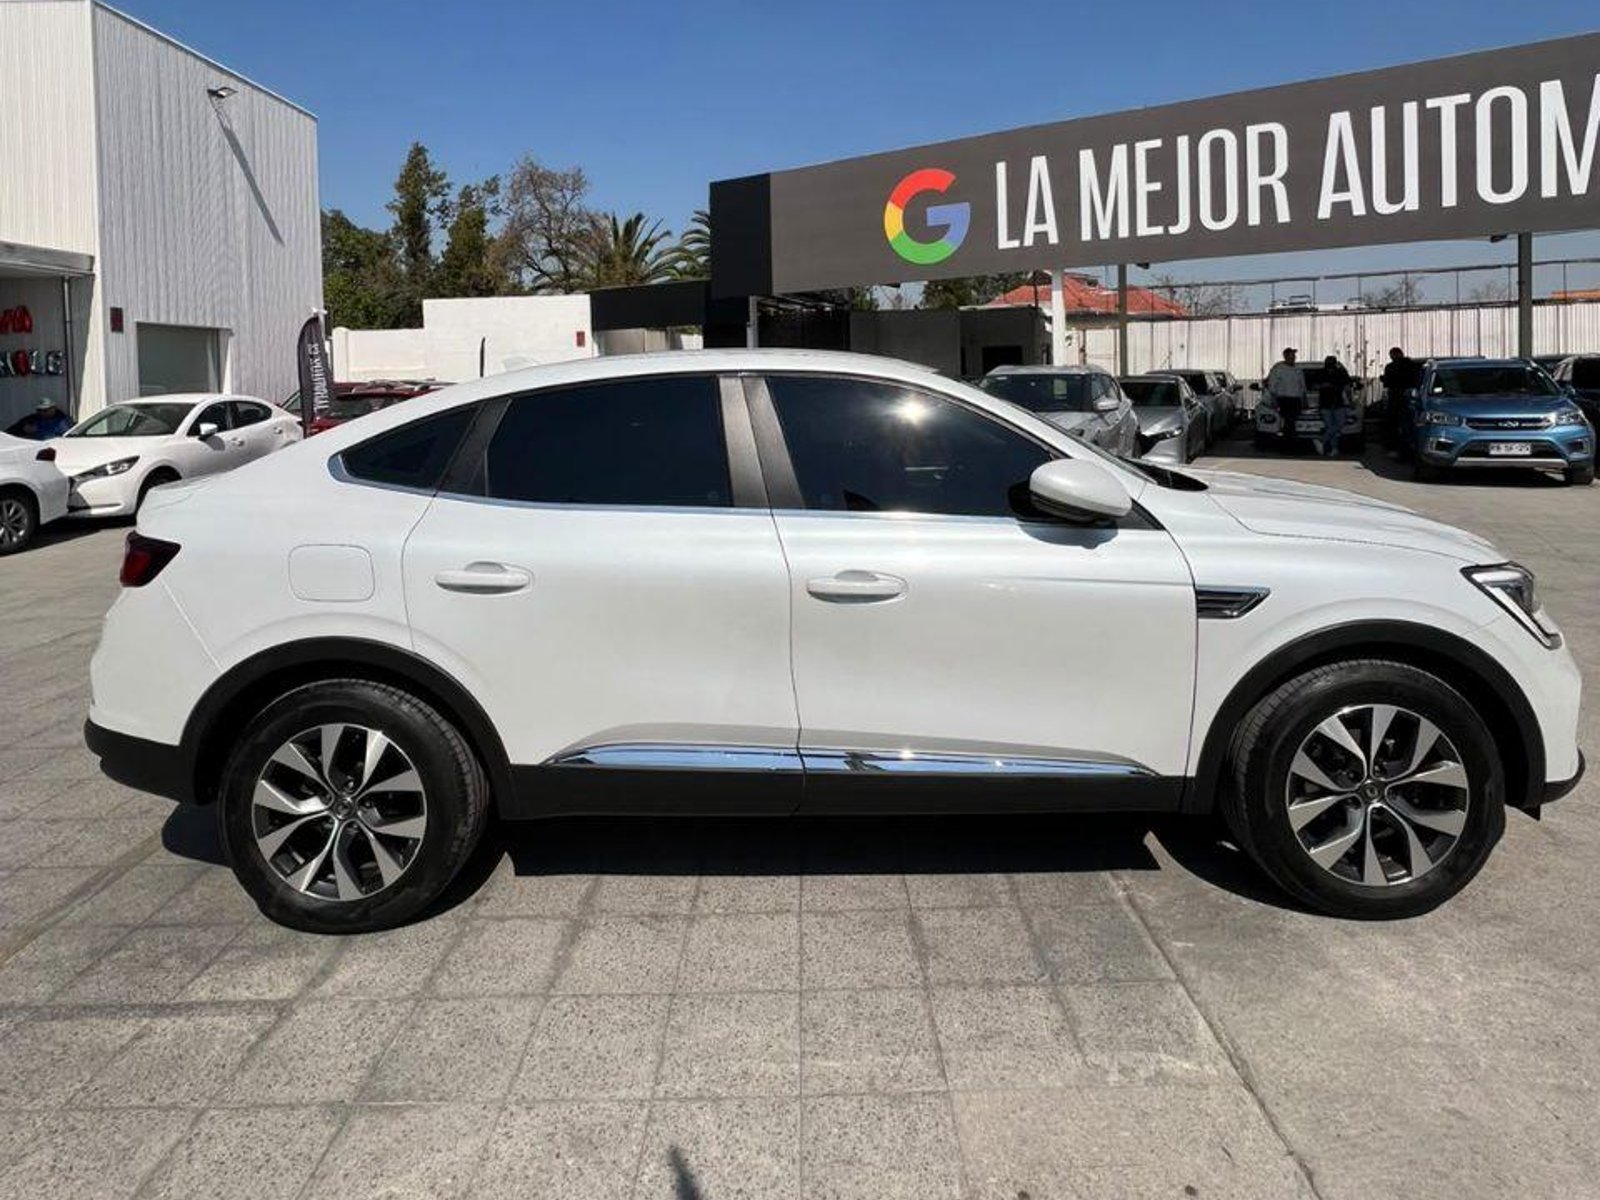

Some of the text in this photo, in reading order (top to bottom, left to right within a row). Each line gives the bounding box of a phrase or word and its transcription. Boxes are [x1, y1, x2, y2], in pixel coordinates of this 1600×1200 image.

[884, 168, 971, 264] G
[995, 74, 1600, 250] LA MEJOR AUTOM
